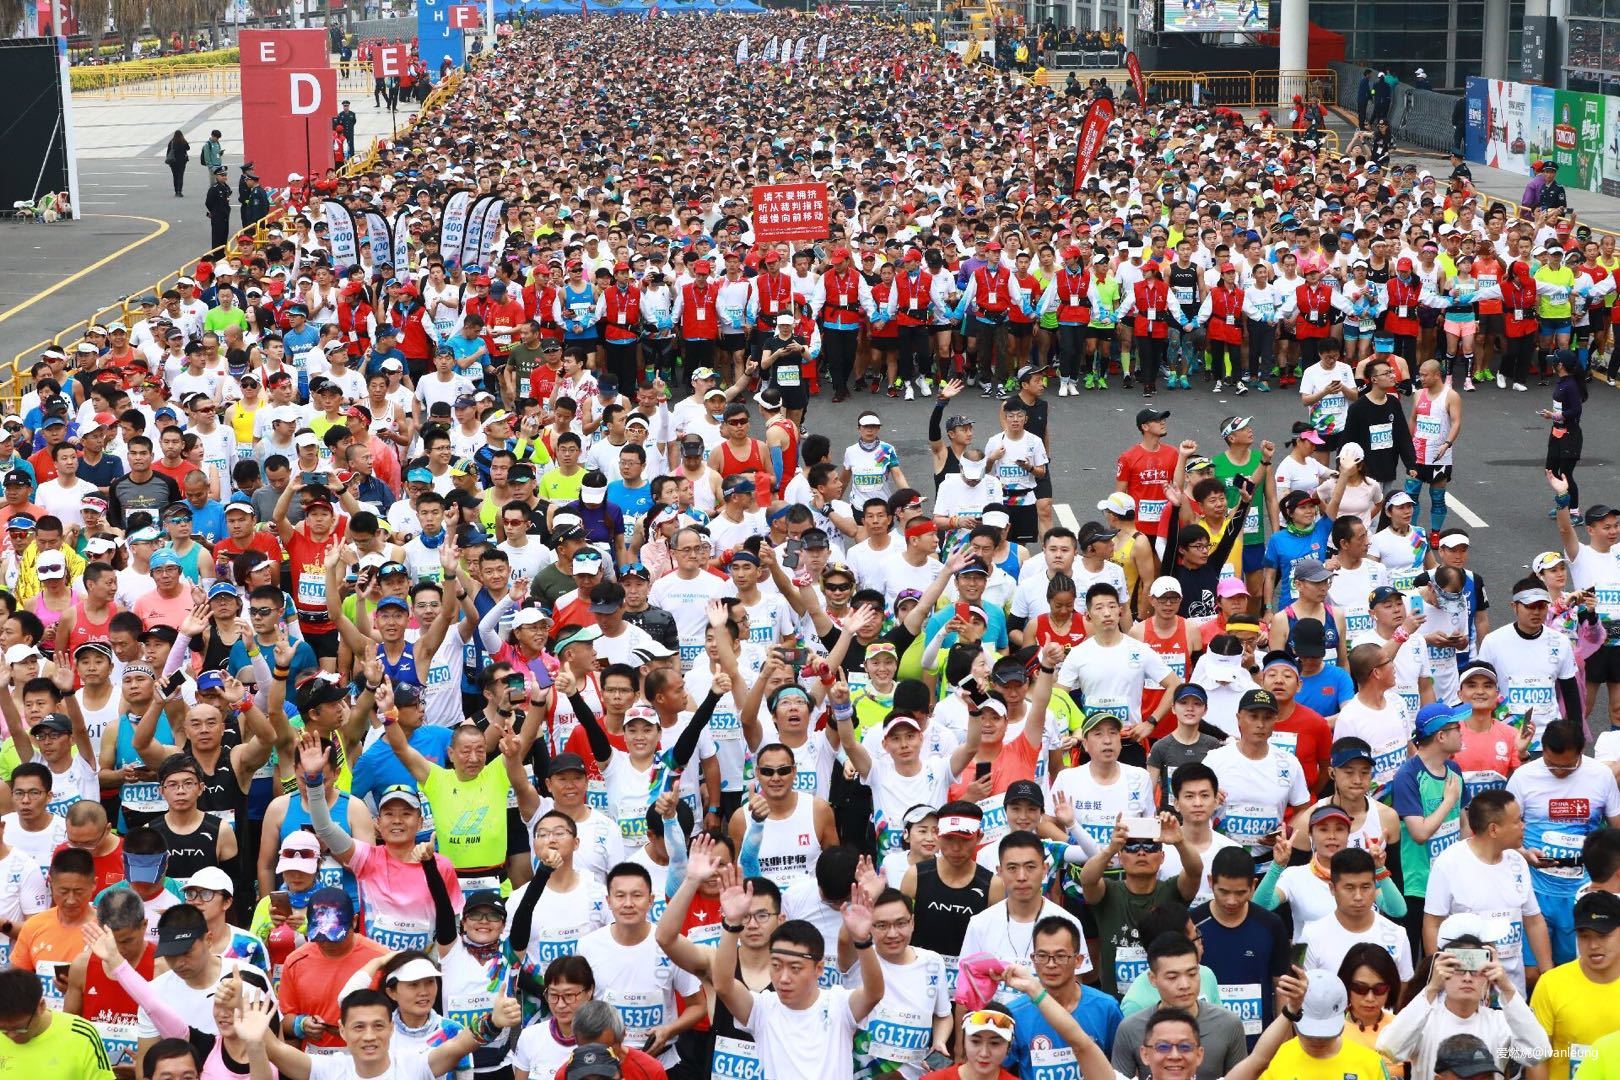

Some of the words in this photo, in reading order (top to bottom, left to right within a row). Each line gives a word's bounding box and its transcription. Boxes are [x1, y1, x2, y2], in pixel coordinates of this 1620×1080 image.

[434, 11, 443, 21] H
[456, 8, 469, 28] F
[442, 27, 449, 37] J
[260, 42, 276, 62] E
[382, 48, 399, 76] E
[290, 73, 321, 115] D
[763, 189, 817, 201] 请不要拥挤
[758, 200, 823, 213] 听从裁判指挥
[758, 211, 824, 224] 缓慢向前移动
[444, 223, 462, 233] 400
[333, 232, 353, 243] 400
[1509, 688, 1551, 704] G14092
[1074, 800, 1103, 811] 赵章挺
[1226, 820, 1276, 836] G14842
[448, 836, 461, 845] ALL
[465, 835, 481, 844] RUN
[927, 901, 974, 915] ANTA
[372, 930, 426, 952] G15543
[874, 1023, 932, 1049] G13770
